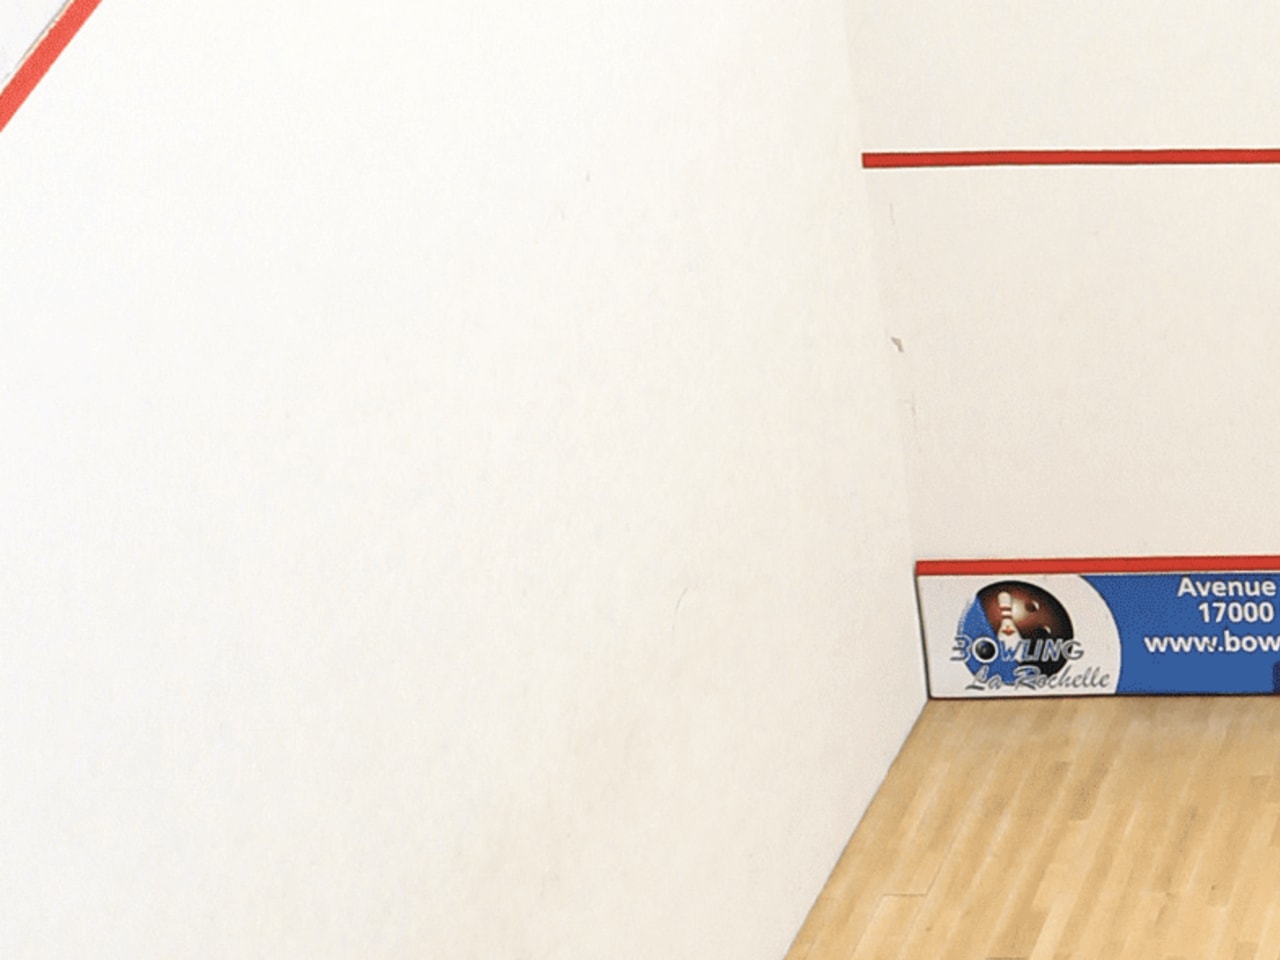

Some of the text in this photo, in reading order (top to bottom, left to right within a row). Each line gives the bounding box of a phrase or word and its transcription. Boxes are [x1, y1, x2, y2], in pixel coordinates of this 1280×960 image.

[1177, 576, 1277, 597] Avenue
[1198, 601, 1274, 623] 17000
[950, 635, 1085, 663] BOWLING
[965, 664, 1110, 691] La Rochelle
